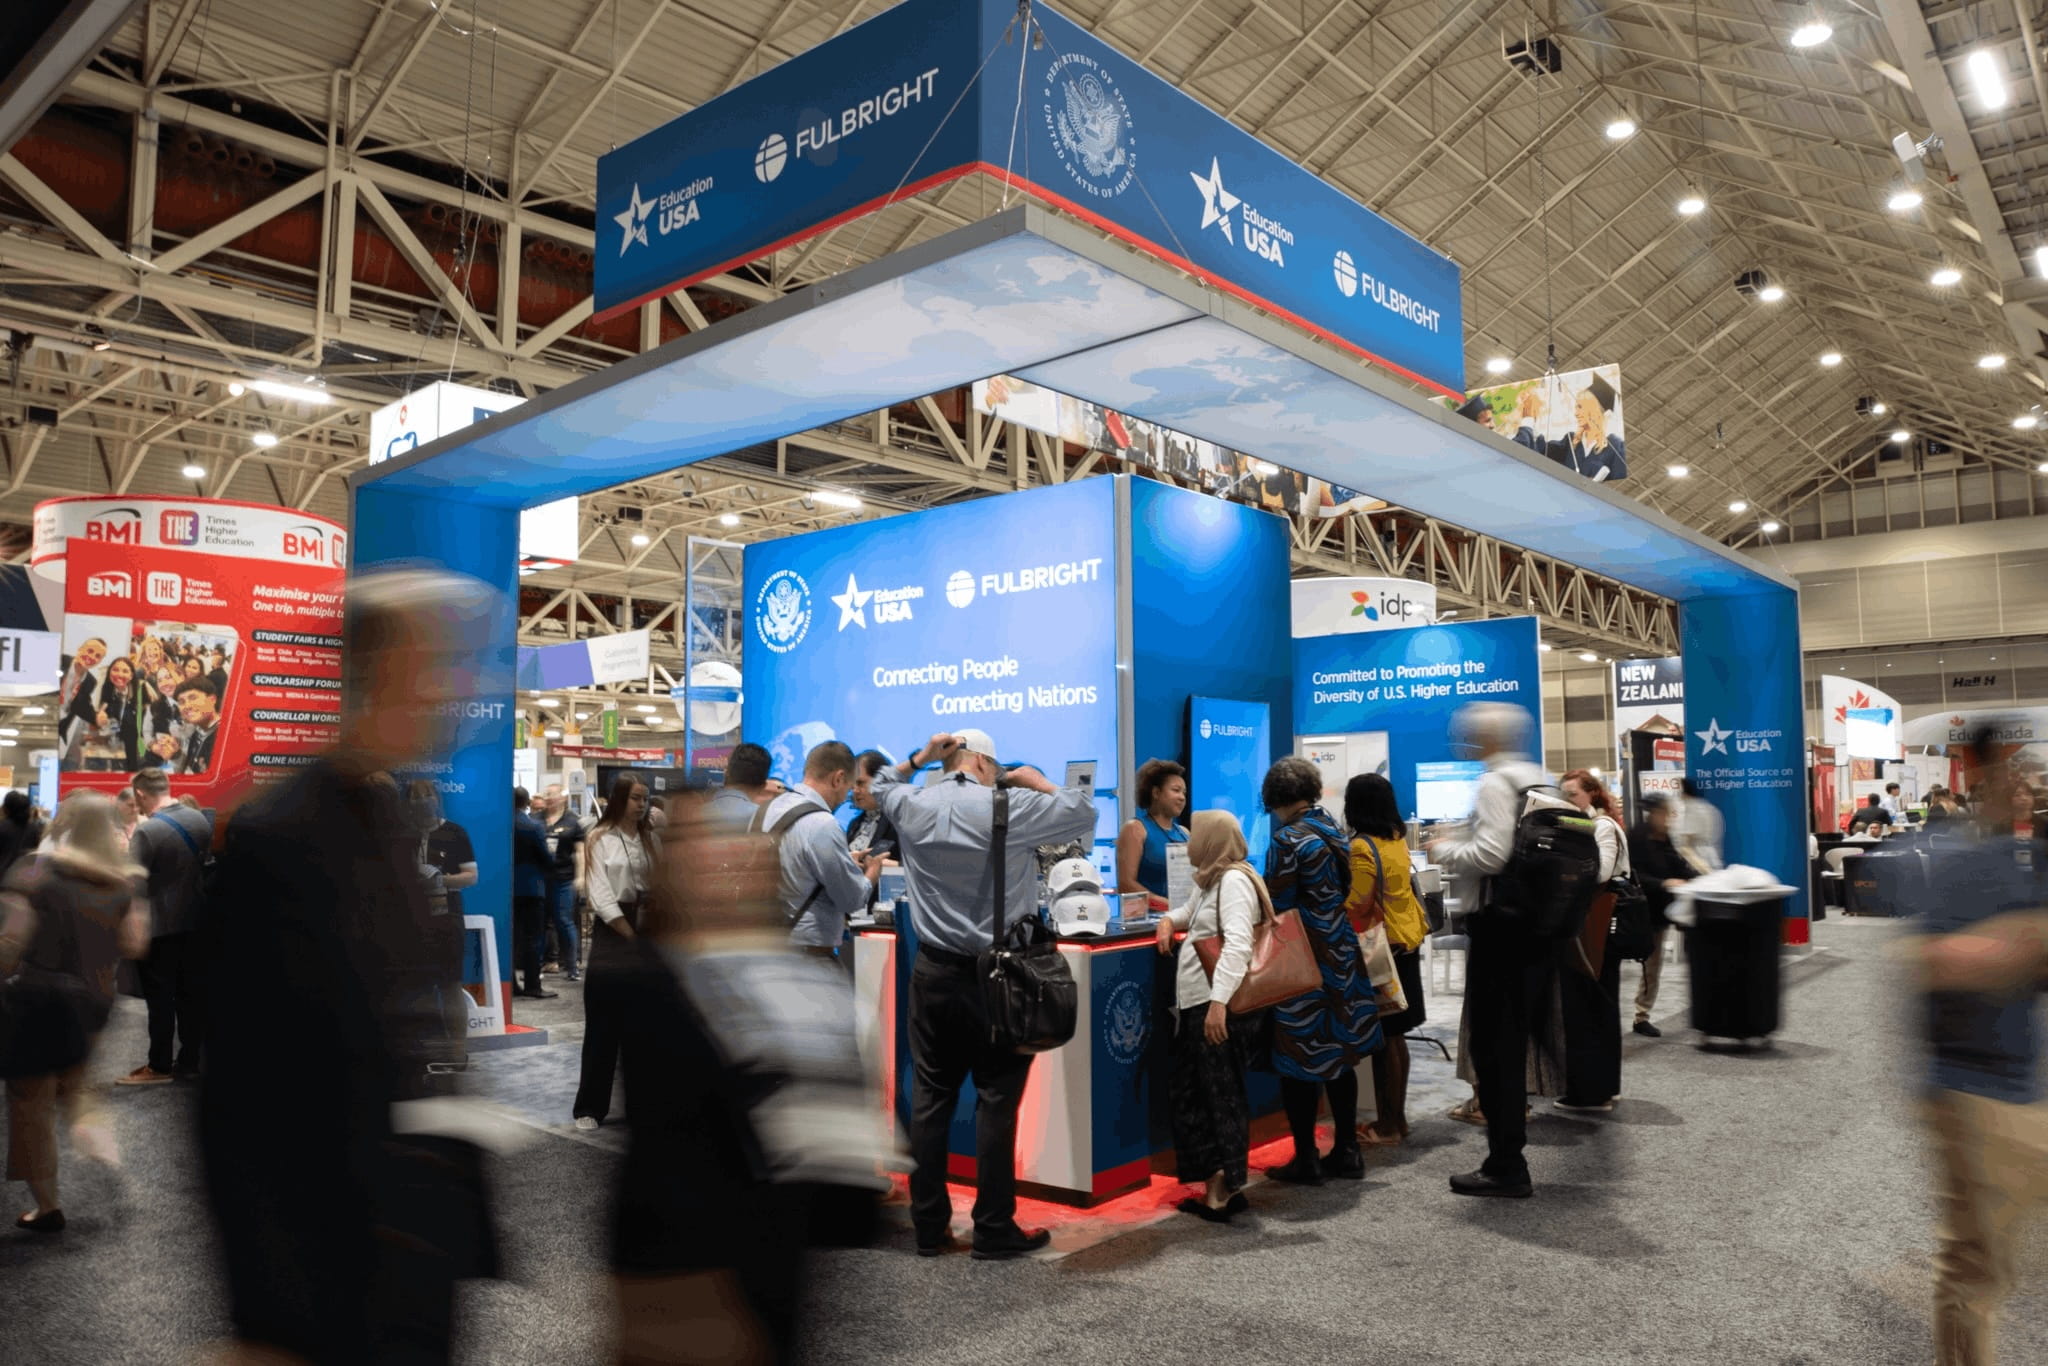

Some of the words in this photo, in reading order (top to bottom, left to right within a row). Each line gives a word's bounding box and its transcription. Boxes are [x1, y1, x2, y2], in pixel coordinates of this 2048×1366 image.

[1046, 52, 1099, 84] DEPARTMENT
[1100, 69, 1113, 84] OF
[1113, 88, 1134, 128] STATE
[796, 67, 939, 159] FULBRIGHT
[1043, 104, 1065, 160] UNITED
[1064, 162, 1099, 197] STATES
[1101, 187, 1113, 199] OF
[659, 174, 713, 210] Education
[659, 200, 700, 236] USA
[1242, 202, 1294, 247] Education
[1243, 223, 1285, 269] USA
[1361, 272, 1440, 334] FULBRIGHT
[166, 515, 194, 541] THE
[205, 515, 237, 526] Times
[205, 525, 239, 538] Higher
[205, 535, 255, 548] Education
[282, 532, 324, 563] BMI
[185, 577, 212, 589] Times
[981, 557, 1102, 597] FULBRIGHT
[87, 574, 132, 599] BMI
[153, 578, 175, 600] THE
[185, 587, 214, 598] Higher
[252, 584, 311, 602] Maximise
[310, 592, 338, 604] your
[874, 585, 924, 603] Education
[185, 596, 228, 608] Education
[252, 600, 274, 612] One
[274, 603, 295, 616] trip,
[297, 605, 336, 619] multiple
[1380, 591, 1413, 622] idp
[874, 600, 913, 624] USA
[255, 631, 294, 643] STUDENT
[294, 634, 318, 645] FAIRS
[317, 637, 324, 645] &
[873, 661, 958, 688] Connecting
[962, 654, 1019, 682] People
[1312, 666, 1377, 685] Committed
[1380, 667, 1394, 681] to
[1396, 662, 1461, 679] Promoting
[1463, 660, 1486, 674] the
[1620, 664, 1656, 683] NEW
[254, 674, 315, 688] SCHOLARSHIP
[1952, 676, 1981, 688] Hall
[1983, 676, 1996, 686] H
[931, 688, 1023, 716] Connecting
[1028, 682, 1098, 709] Nations
[1313, 688, 1364, 704] Diversity
[1366, 687, 1380, 701] of
[1383, 685, 1407, 700] U.S.
[1410, 683, 1452, 699] Higher
[1456, 678, 1519, 695] Education
[1620, 682, 1684, 702] ZEALAN
[253, 710, 311, 721] COUNSELLOR
[430, 702, 505, 720] BRIGHT
[1213, 723, 1253, 737] FULBRIGHT
[1735, 729, 1782, 739] Education
[1948, 726, 2034, 742] Edunada
[1735, 738, 1772, 753] USA
[253, 755, 287, 765] ONLINE
[1320, 752, 1336, 762] idp
[1696, 769, 1713, 778] The
[1714, 767, 1745, 778] Official
[1747, 767, 1778, 778] Source
[1780, 768, 1793, 777] on
[1643, 778, 1681, 791] PRAG
[1696, 780, 1713, 790] U.S.
[1715, 779, 1745, 791] Higher
[1747, 778, 1793, 789] Education
